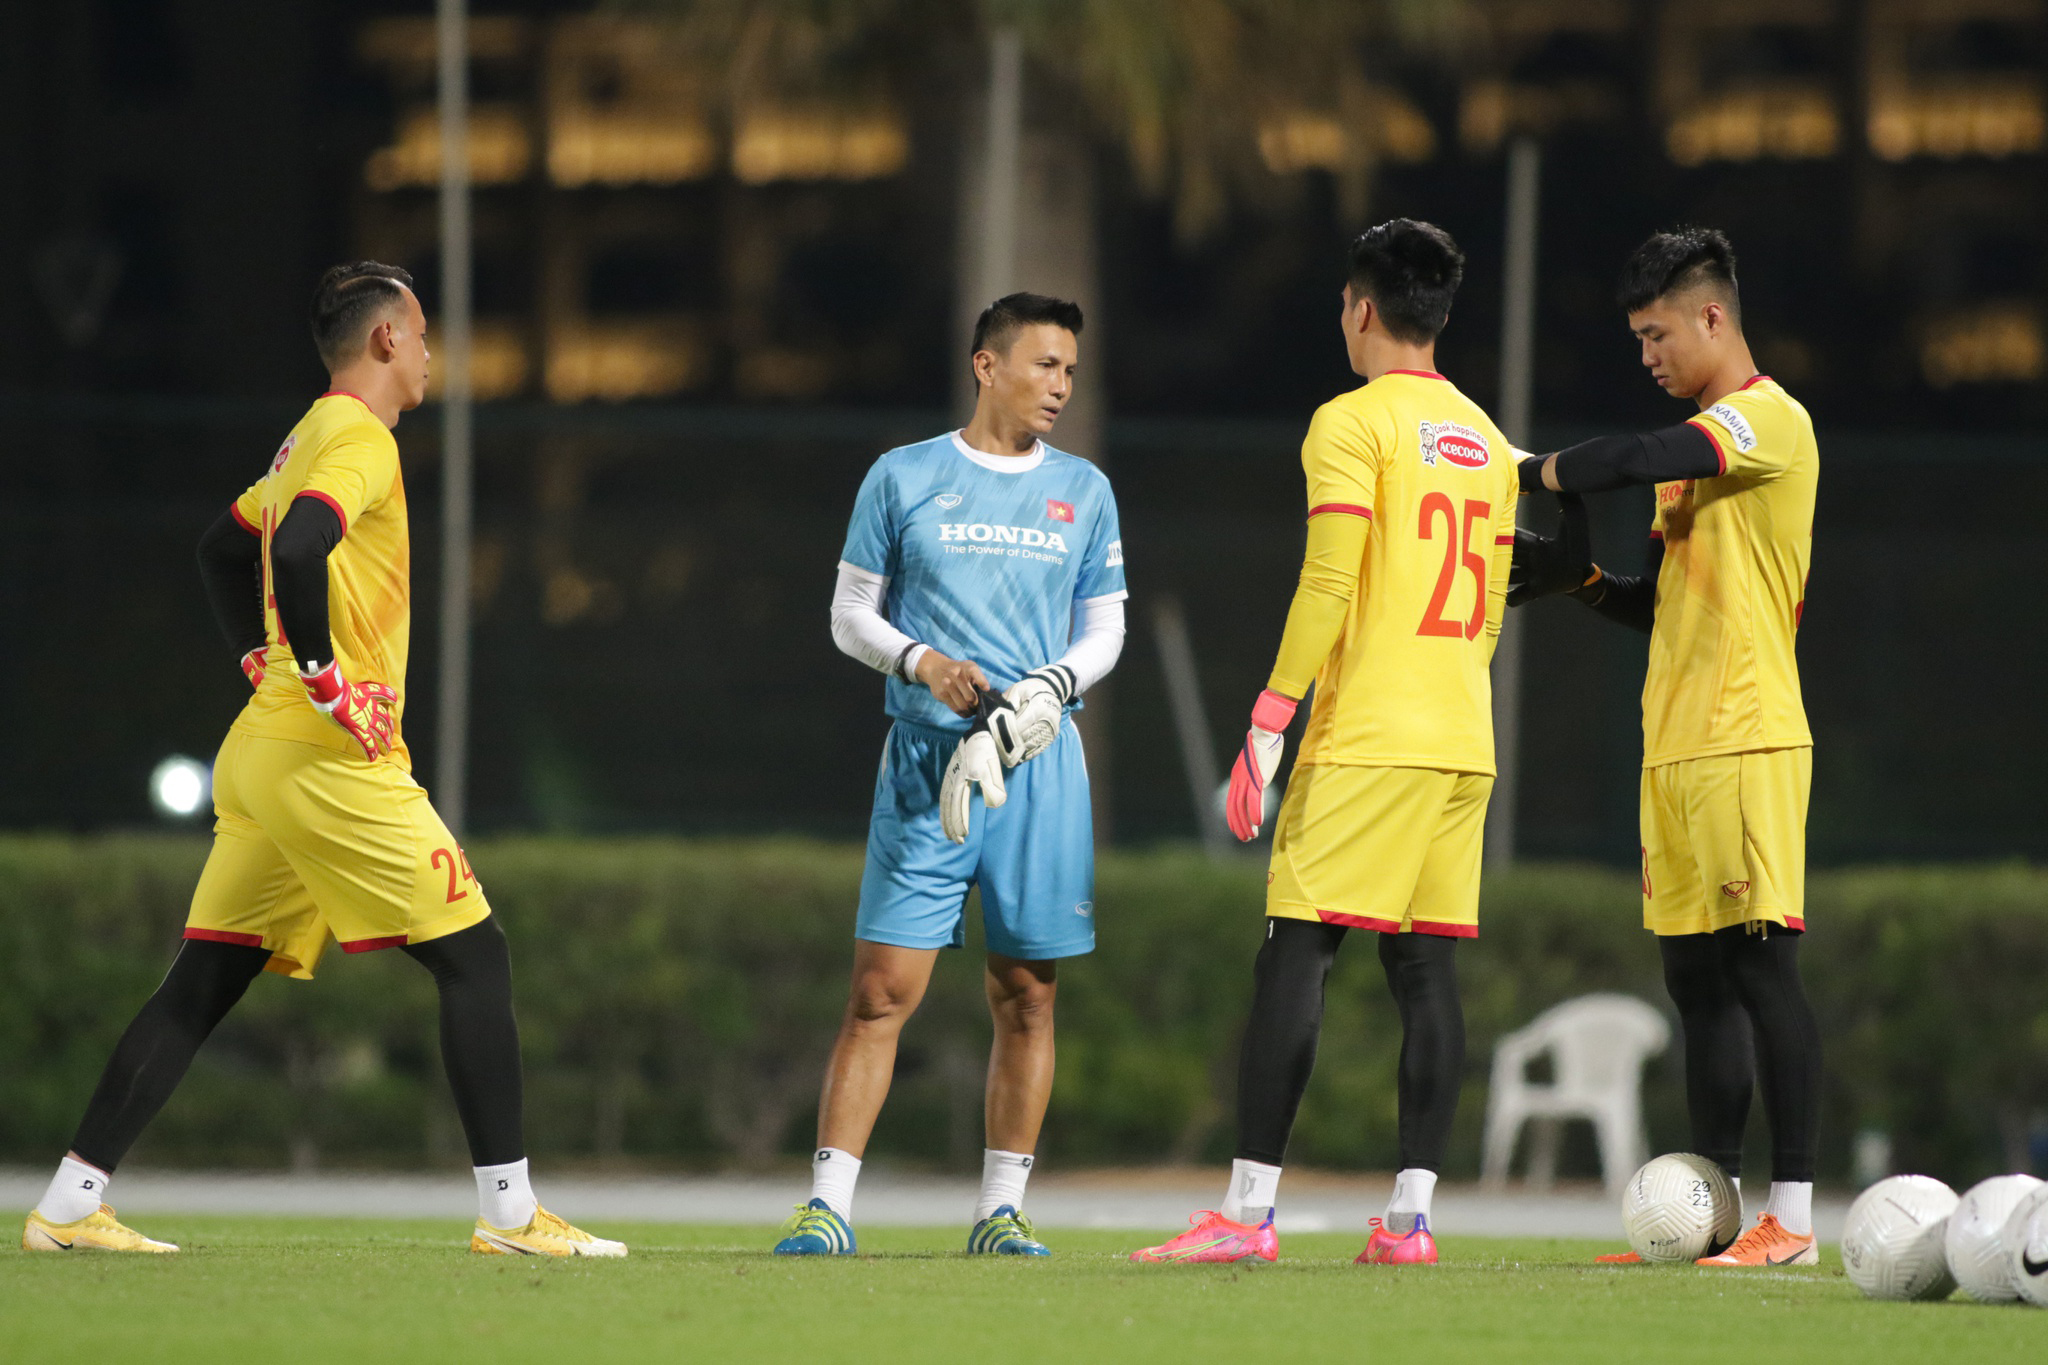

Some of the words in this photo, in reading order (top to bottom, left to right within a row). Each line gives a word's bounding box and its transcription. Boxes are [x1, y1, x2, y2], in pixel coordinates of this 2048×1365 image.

[1434, 423, 1450, 434] Cook
[1451, 423, 1488, 447] happiness
[1714, 405, 1752, 450] NAMILK
[938, 523, 1069, 553] HONDA
[943, 544, 965, 554] The
[968, 545, 1006, 556] Power
[1008, 547, 1020, 557] of
[1022, 549, 1064, 565] Dreams
[1416, 491, 1491, 642] 25
[431, 841, 479, 904] 24
[1657, 1236, 1681, 1247] FLIGHT
